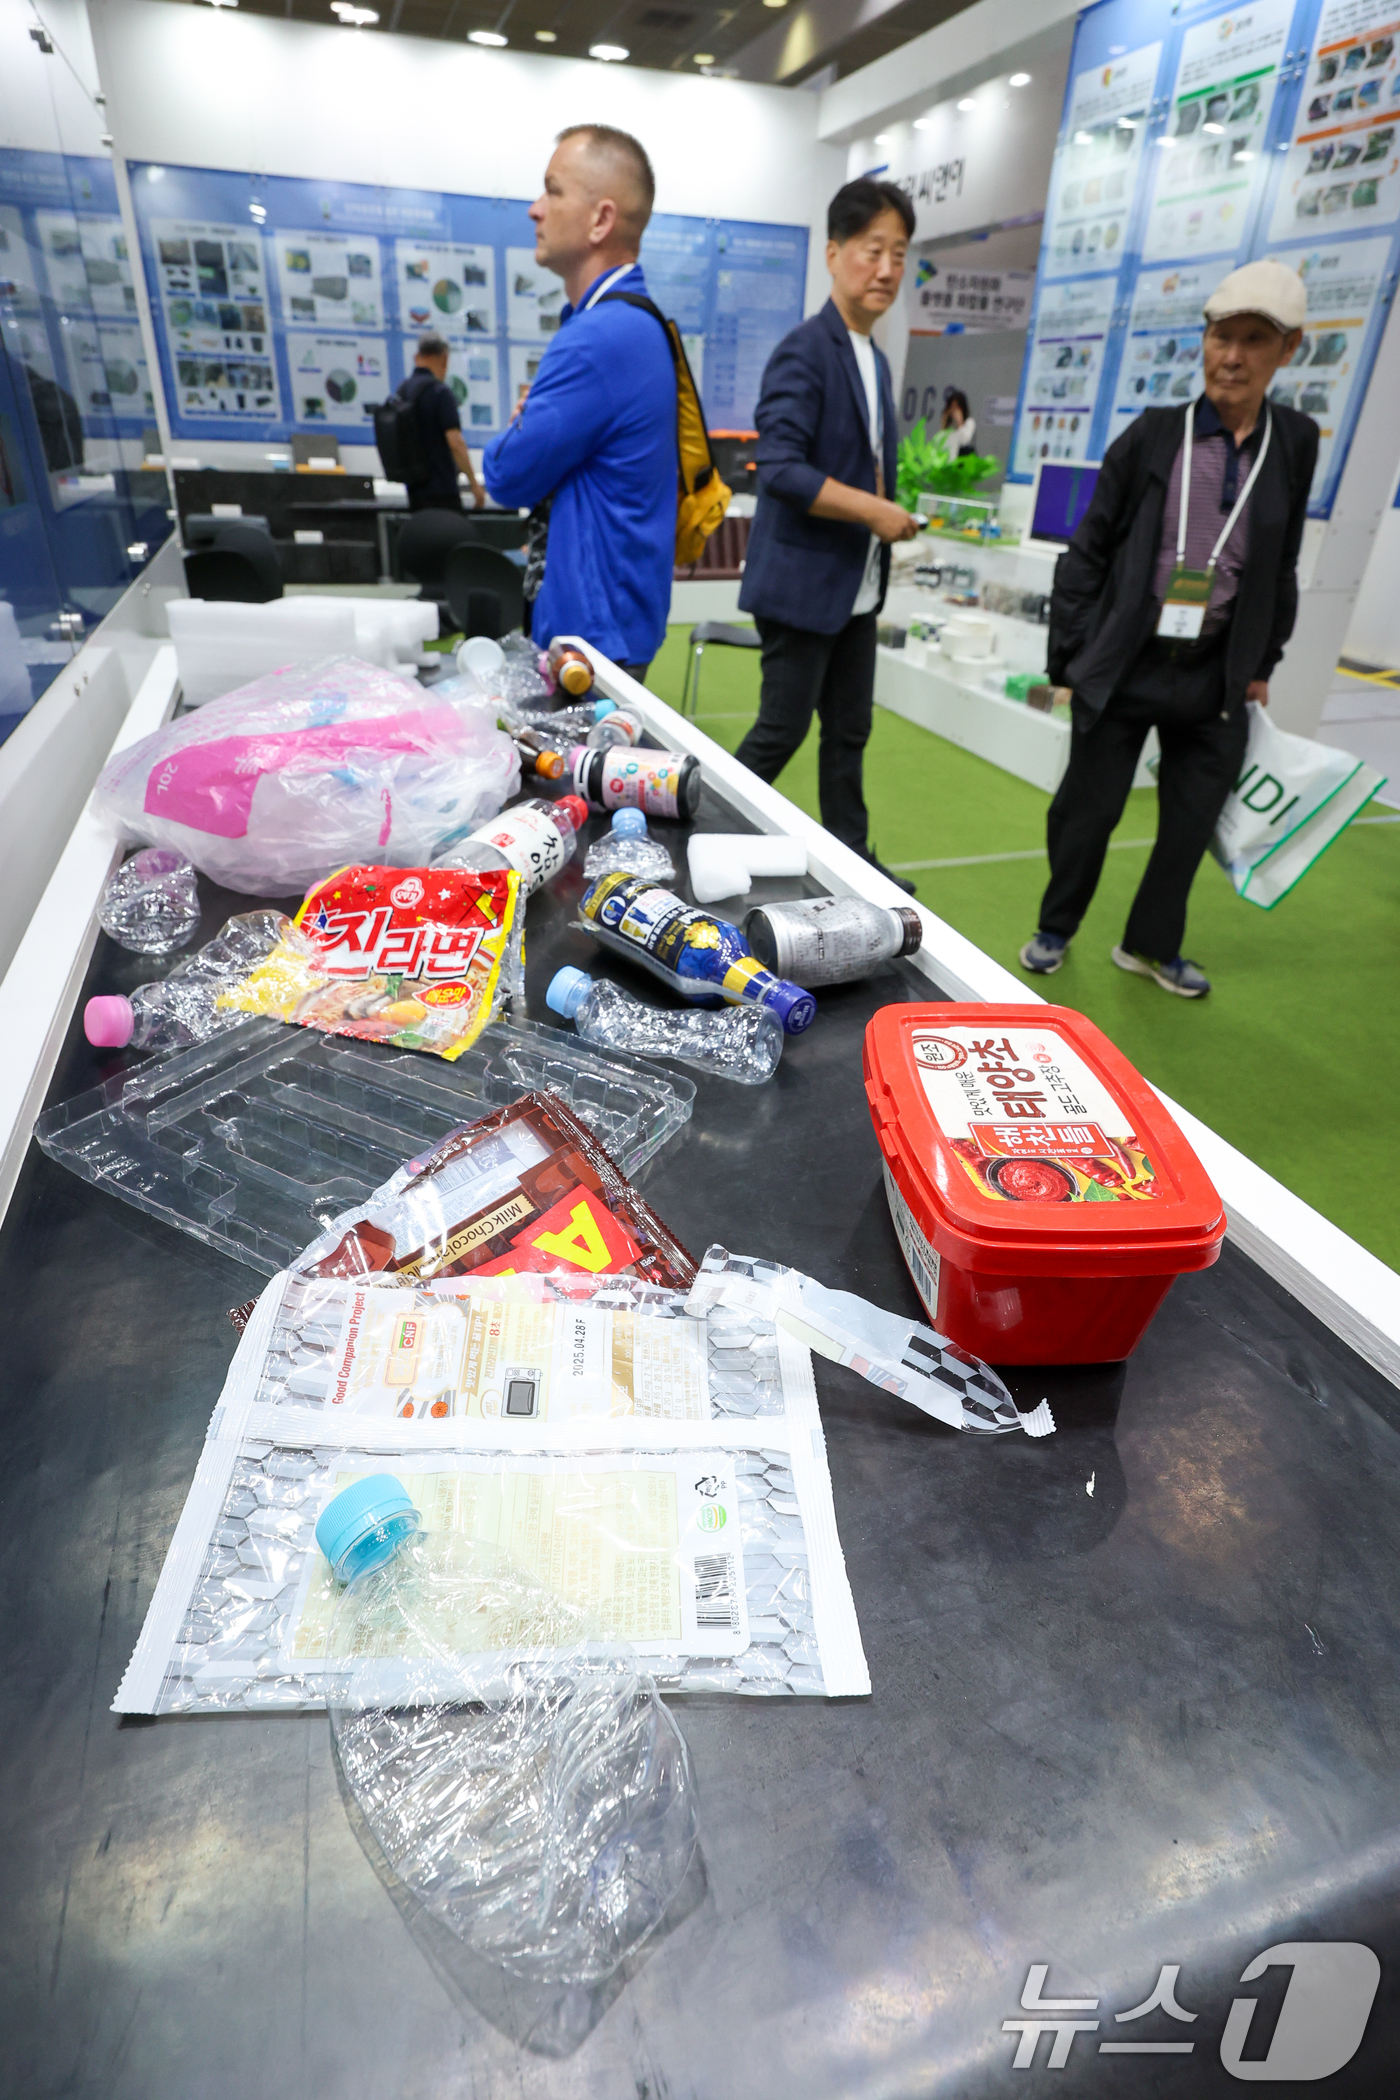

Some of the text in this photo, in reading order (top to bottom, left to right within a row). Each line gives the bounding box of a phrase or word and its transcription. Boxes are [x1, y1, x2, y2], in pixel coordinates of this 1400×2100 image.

[156, 762, 178, 796] 20L
[319, 907, 481, 979] 진라면
[425, 986, 467, 1004] 매운맛
[921, 1044, 944, 1061] 원조
[955, 1070, 977, 1087] 매운
[967, 1038, 1047, 1118] 태양초
[1039, 1064, 1087, 1115] 골드 고추장
[967, 1089, 993, 1116] 맛있게
[993, 1126, 1095, 1147] 해찬들
[491, 1203, 523, 1226] Milk
[489, 1321, 501, 1336] 8초
[331, 1291, 366, 1404] Good Companion Project
[469, 1342, 480, 1359] 먹는
[465, 1360, 477, 1388] 맛있게
[720, 1480, 728, 1489] PP
